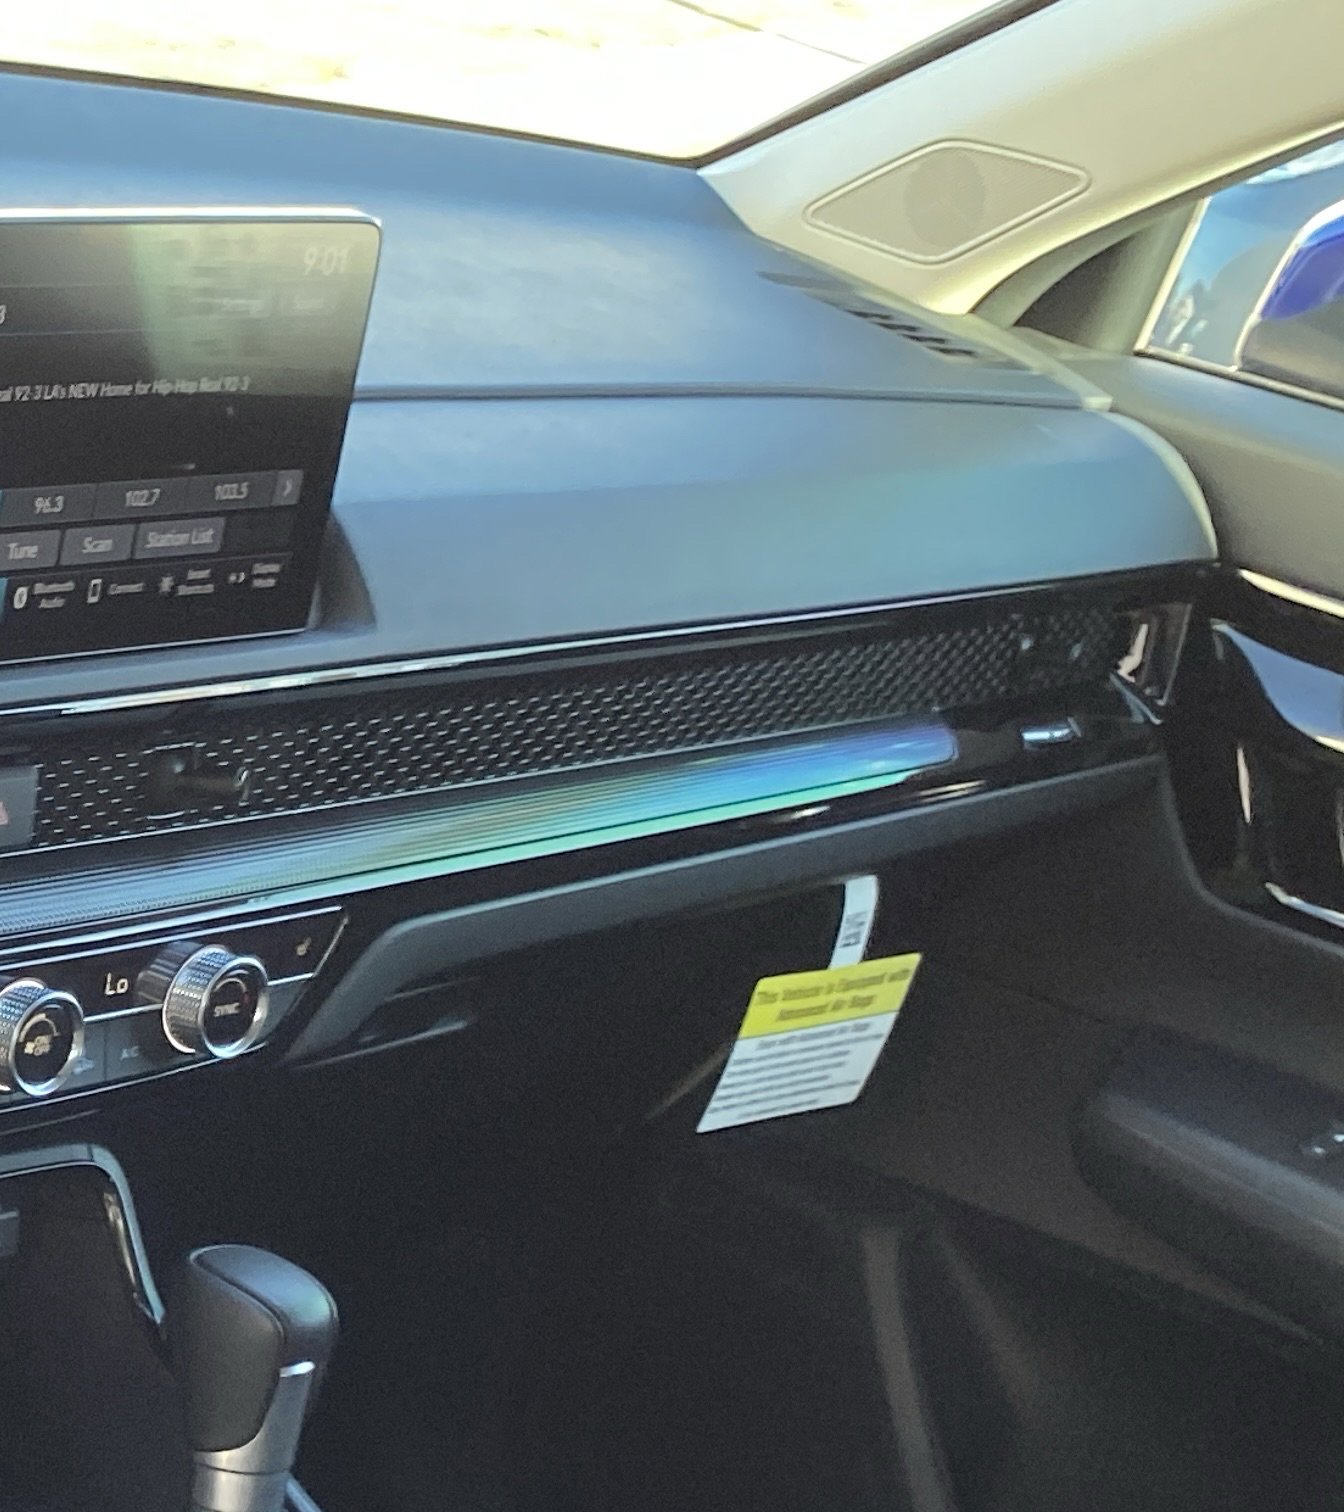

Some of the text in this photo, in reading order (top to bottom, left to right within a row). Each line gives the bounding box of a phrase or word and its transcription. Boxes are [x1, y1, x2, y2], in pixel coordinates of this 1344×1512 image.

[67, 383, 100, 399] NEW
[33, 495, 66, 516] 96.3
[125, 488, 162, 508] 102.7
[8, 542, 39, 561] Tune
[81, 536, 113, 554] Scan
[104, 971, 129, 996] Lo
[213, 1002, 239, 1017] SYNC
